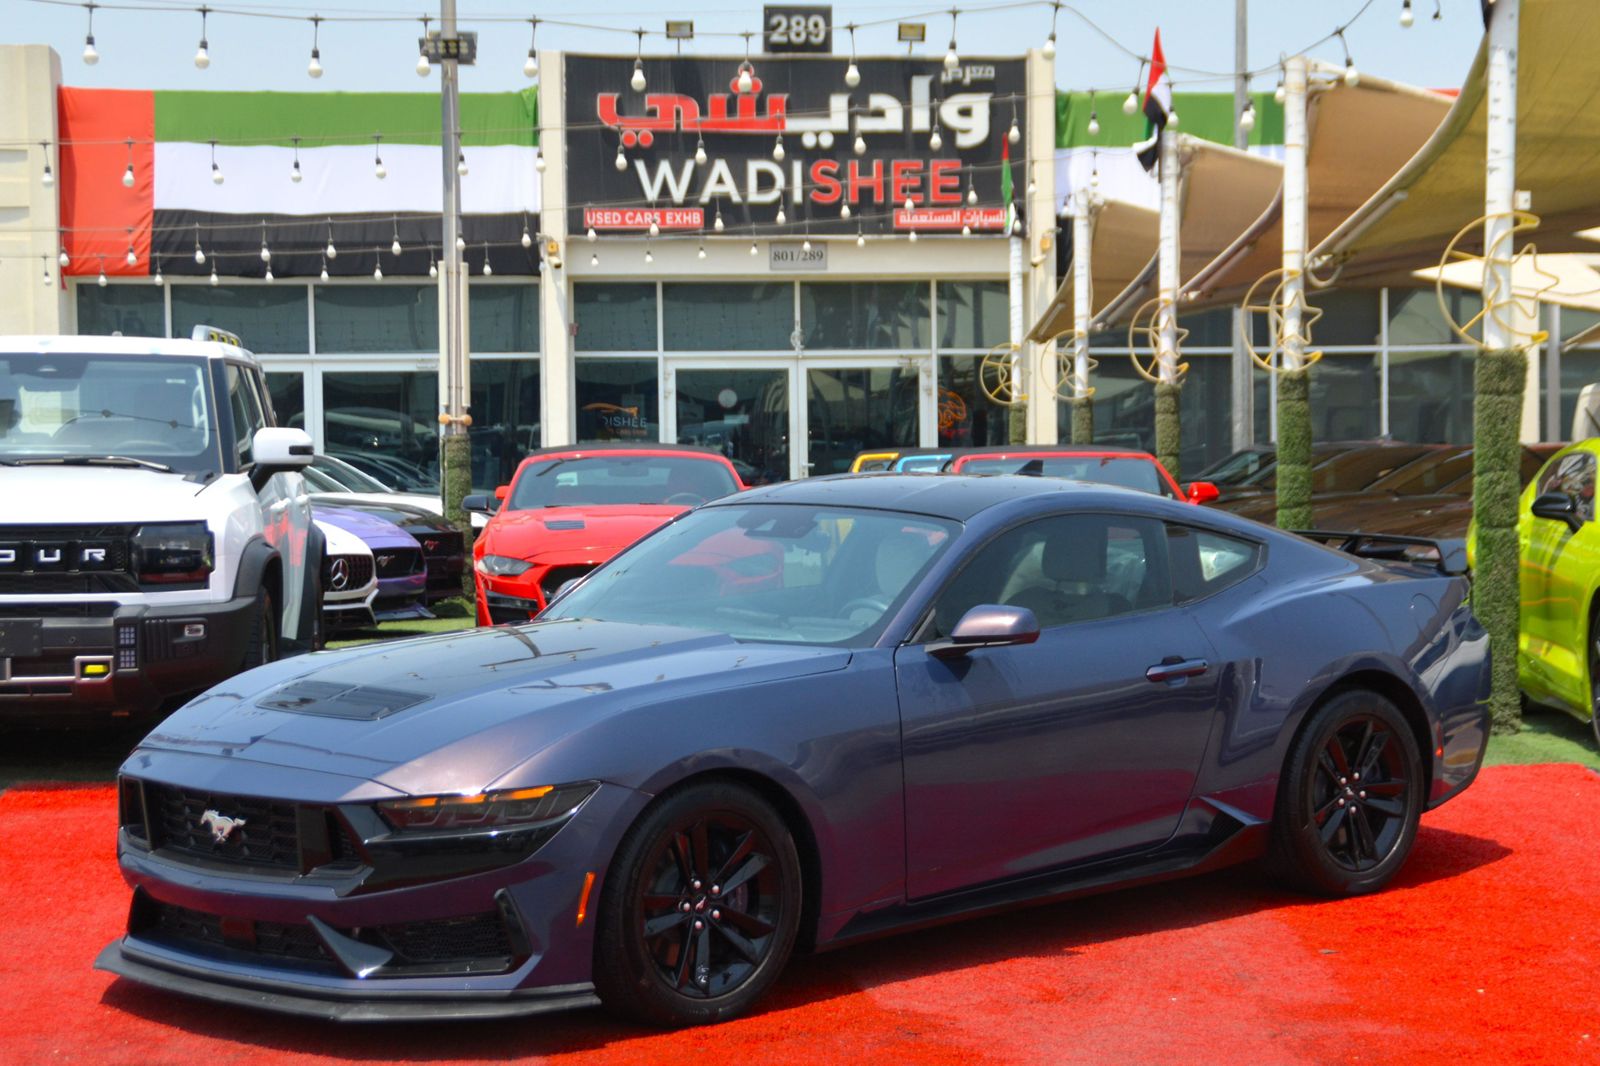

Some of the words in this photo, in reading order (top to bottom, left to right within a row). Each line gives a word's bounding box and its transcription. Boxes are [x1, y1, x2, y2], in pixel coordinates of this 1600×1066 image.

[769, 14, 826, 44] 289
[634, 159, 963, 203] WADISHEE
[586, 211, 622, 225] USED
[624, 211, 662, 225] CARS
[665, 211, 701, 225] EXHB
[773, 250, 824, 261] 801/289
